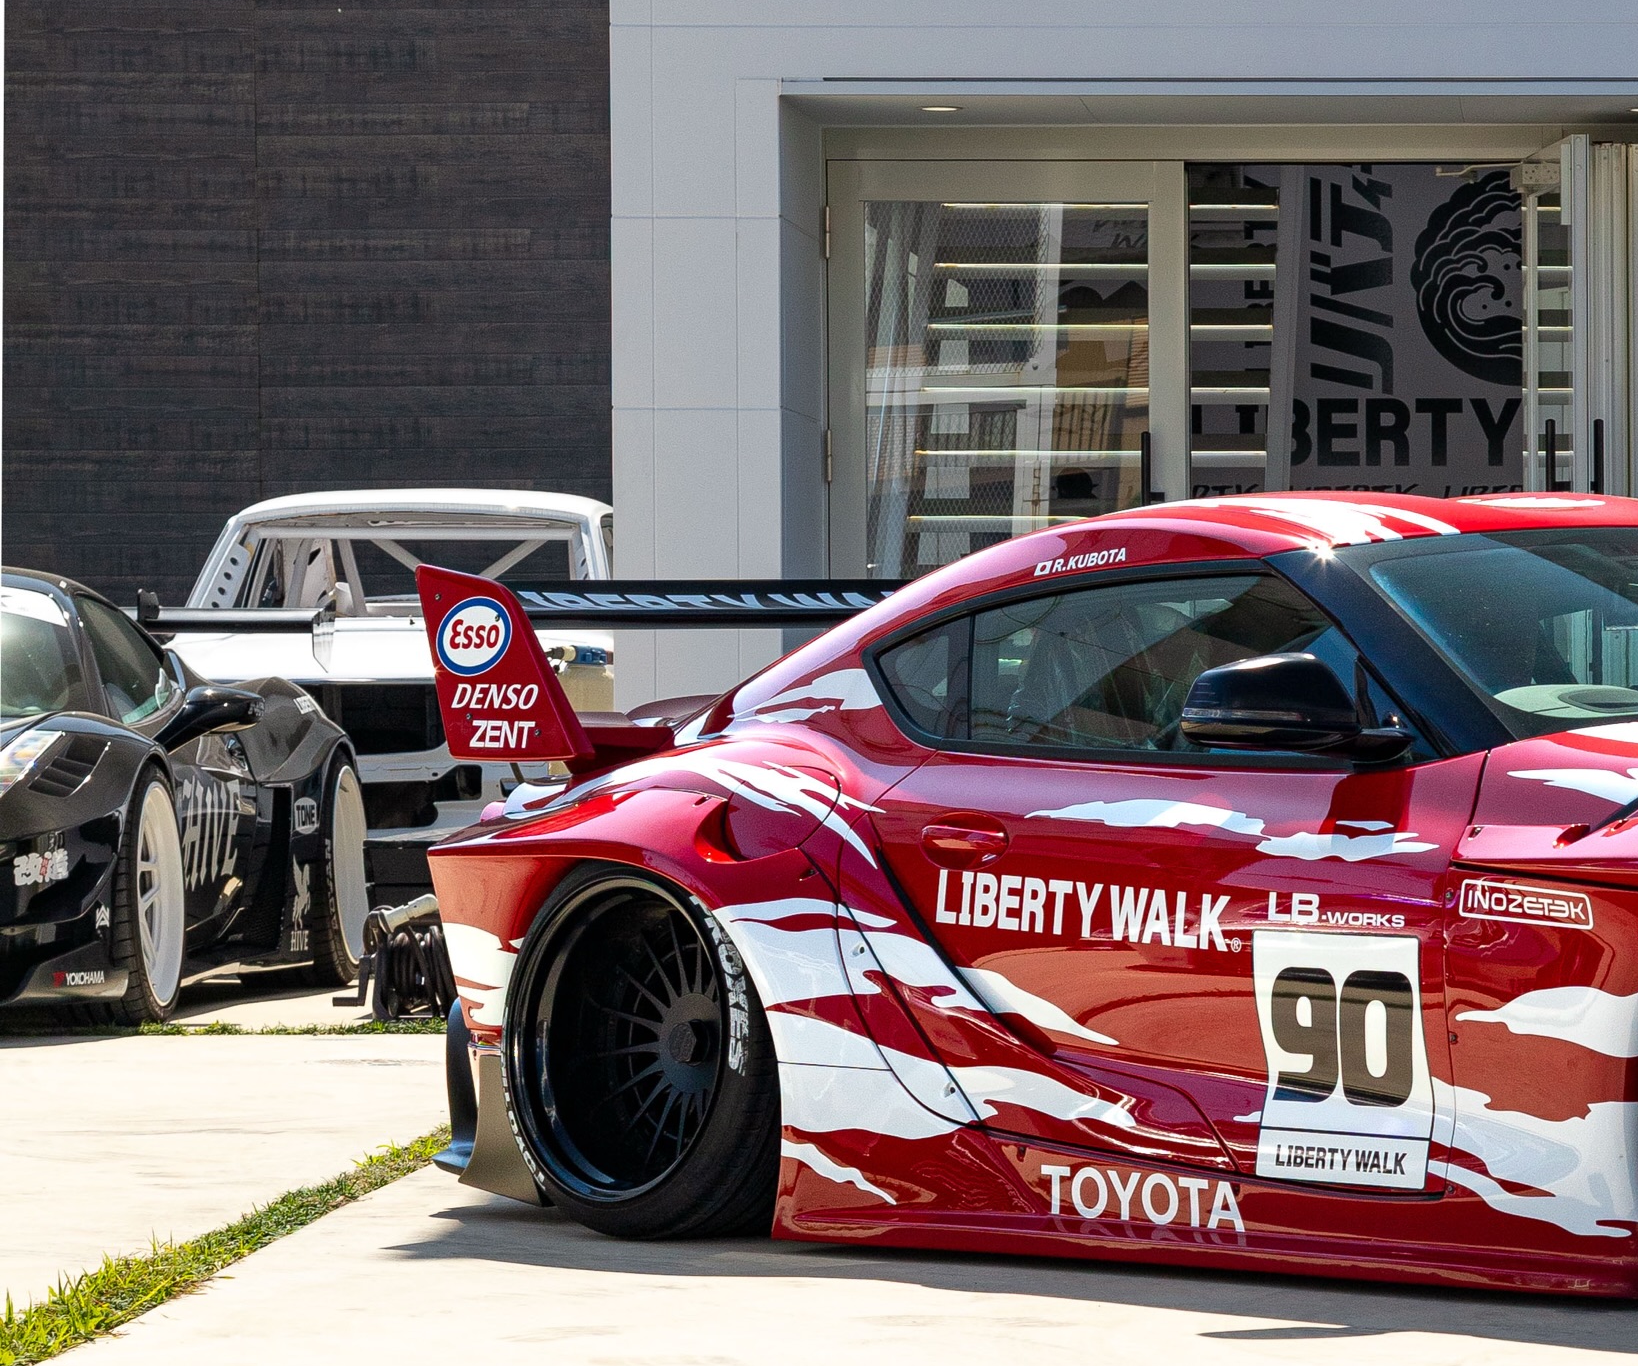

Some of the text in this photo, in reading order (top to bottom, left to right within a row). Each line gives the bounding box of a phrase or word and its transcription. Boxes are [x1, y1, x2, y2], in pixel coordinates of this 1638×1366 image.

[1052, 547, 1127, 574] R.KUBOTA
[451, 683, 539, 710] DENSO
[469, 720, 535, 749] ZENT
[296, 804, 317, 827] TONE
[935, 869, 1104, 938] LIBERTY
[66, 970, 105, 985] YOKOHAMA
[1270, 966, 1414, 1108] 90
[1274, 1144, 1408, 1177] LIBERTY WALK
[1040, 1164, 1246, 1233] TOYOTA
